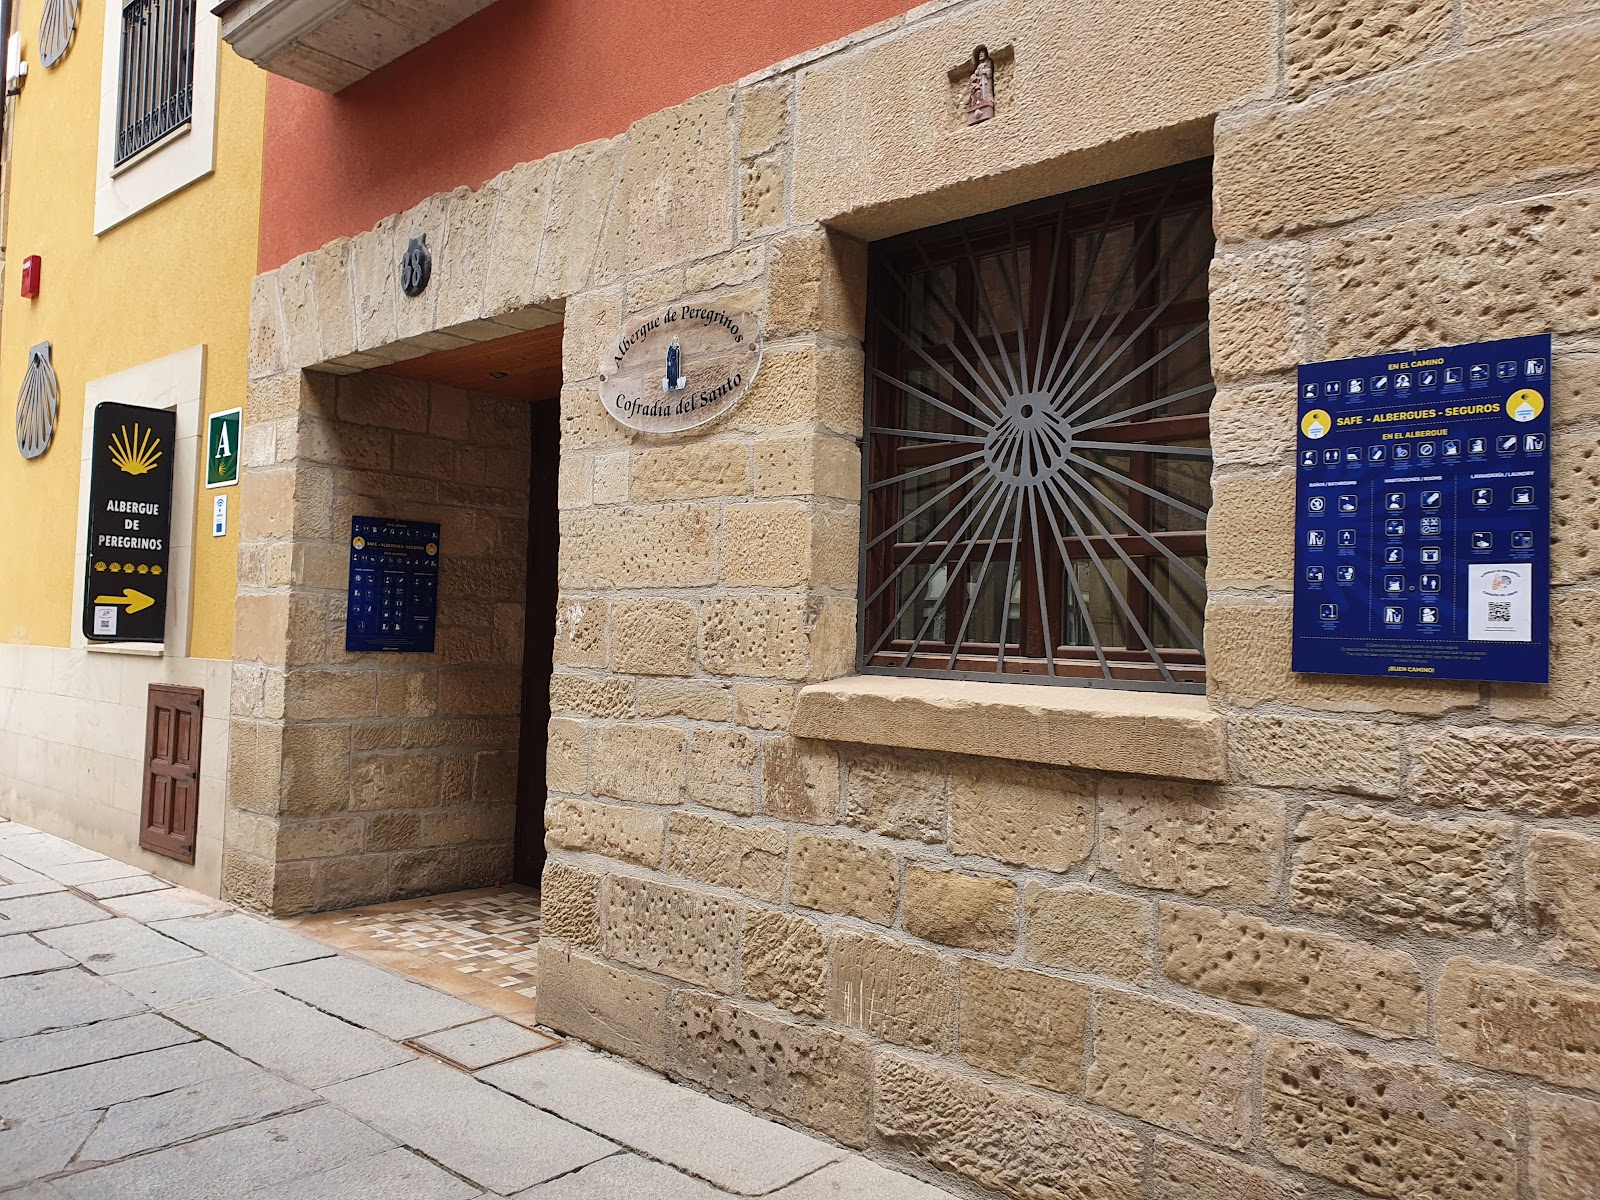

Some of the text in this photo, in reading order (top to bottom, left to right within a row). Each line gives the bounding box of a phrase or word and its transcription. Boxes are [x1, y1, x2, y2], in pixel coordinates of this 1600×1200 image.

[613, 305, 744, 369] Albergue de Peregrinos
[1388, 357, 1445, 371] EN EL CAMINO
[616, 373, 743, 419] Cofradía del Santo
[1336, 416, 1363, 427] SAFE
[1372, 409, 1436, 423] ALBERGUES
[1444, 403, 1501, 417] SEGUROS
[215, 420, 232, 459] A
[1382, 428, 1448, 441] EN EL ALBERGUE
[106, 499, 160, 516] ALBERGUE
[124, 518, 140, 531] DE
[97, 535, 163, 551] PEREGRINOS
